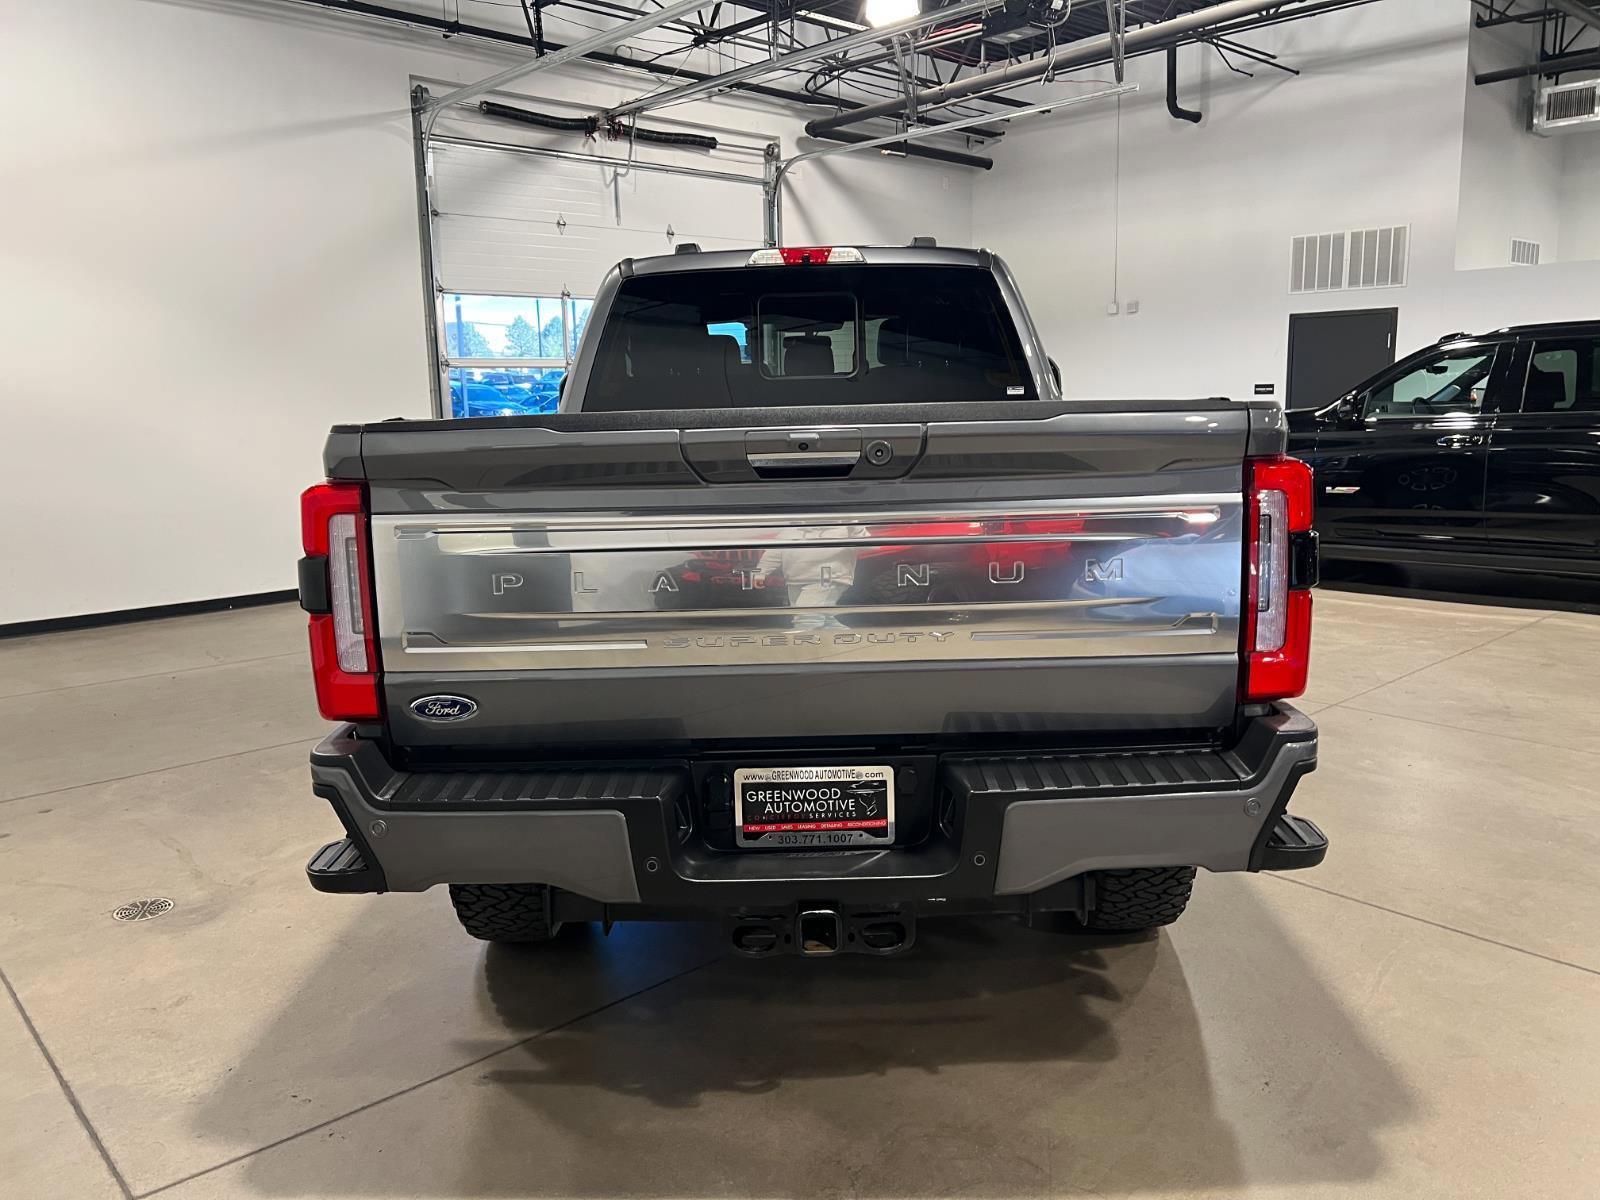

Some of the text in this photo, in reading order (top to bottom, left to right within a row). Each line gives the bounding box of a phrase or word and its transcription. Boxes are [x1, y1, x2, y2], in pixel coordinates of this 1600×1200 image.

[492, 558, 1124, 595] PLATINUM
[663, 631, 953, 648] SUPER DUTY
[415, 701, 461, 715] Ford
[771, 769, 814, 781] GREENWOOD
[814, 768, 856, 779] AUTOMOTIVE
[746, 788, 841, 802] GREENWOOD
[764, 799, 855, 814] AUTOMOTIVE
[809, 811, 856, 819] SERVICES
[778, 833, 853, 845] 303.771.1007
